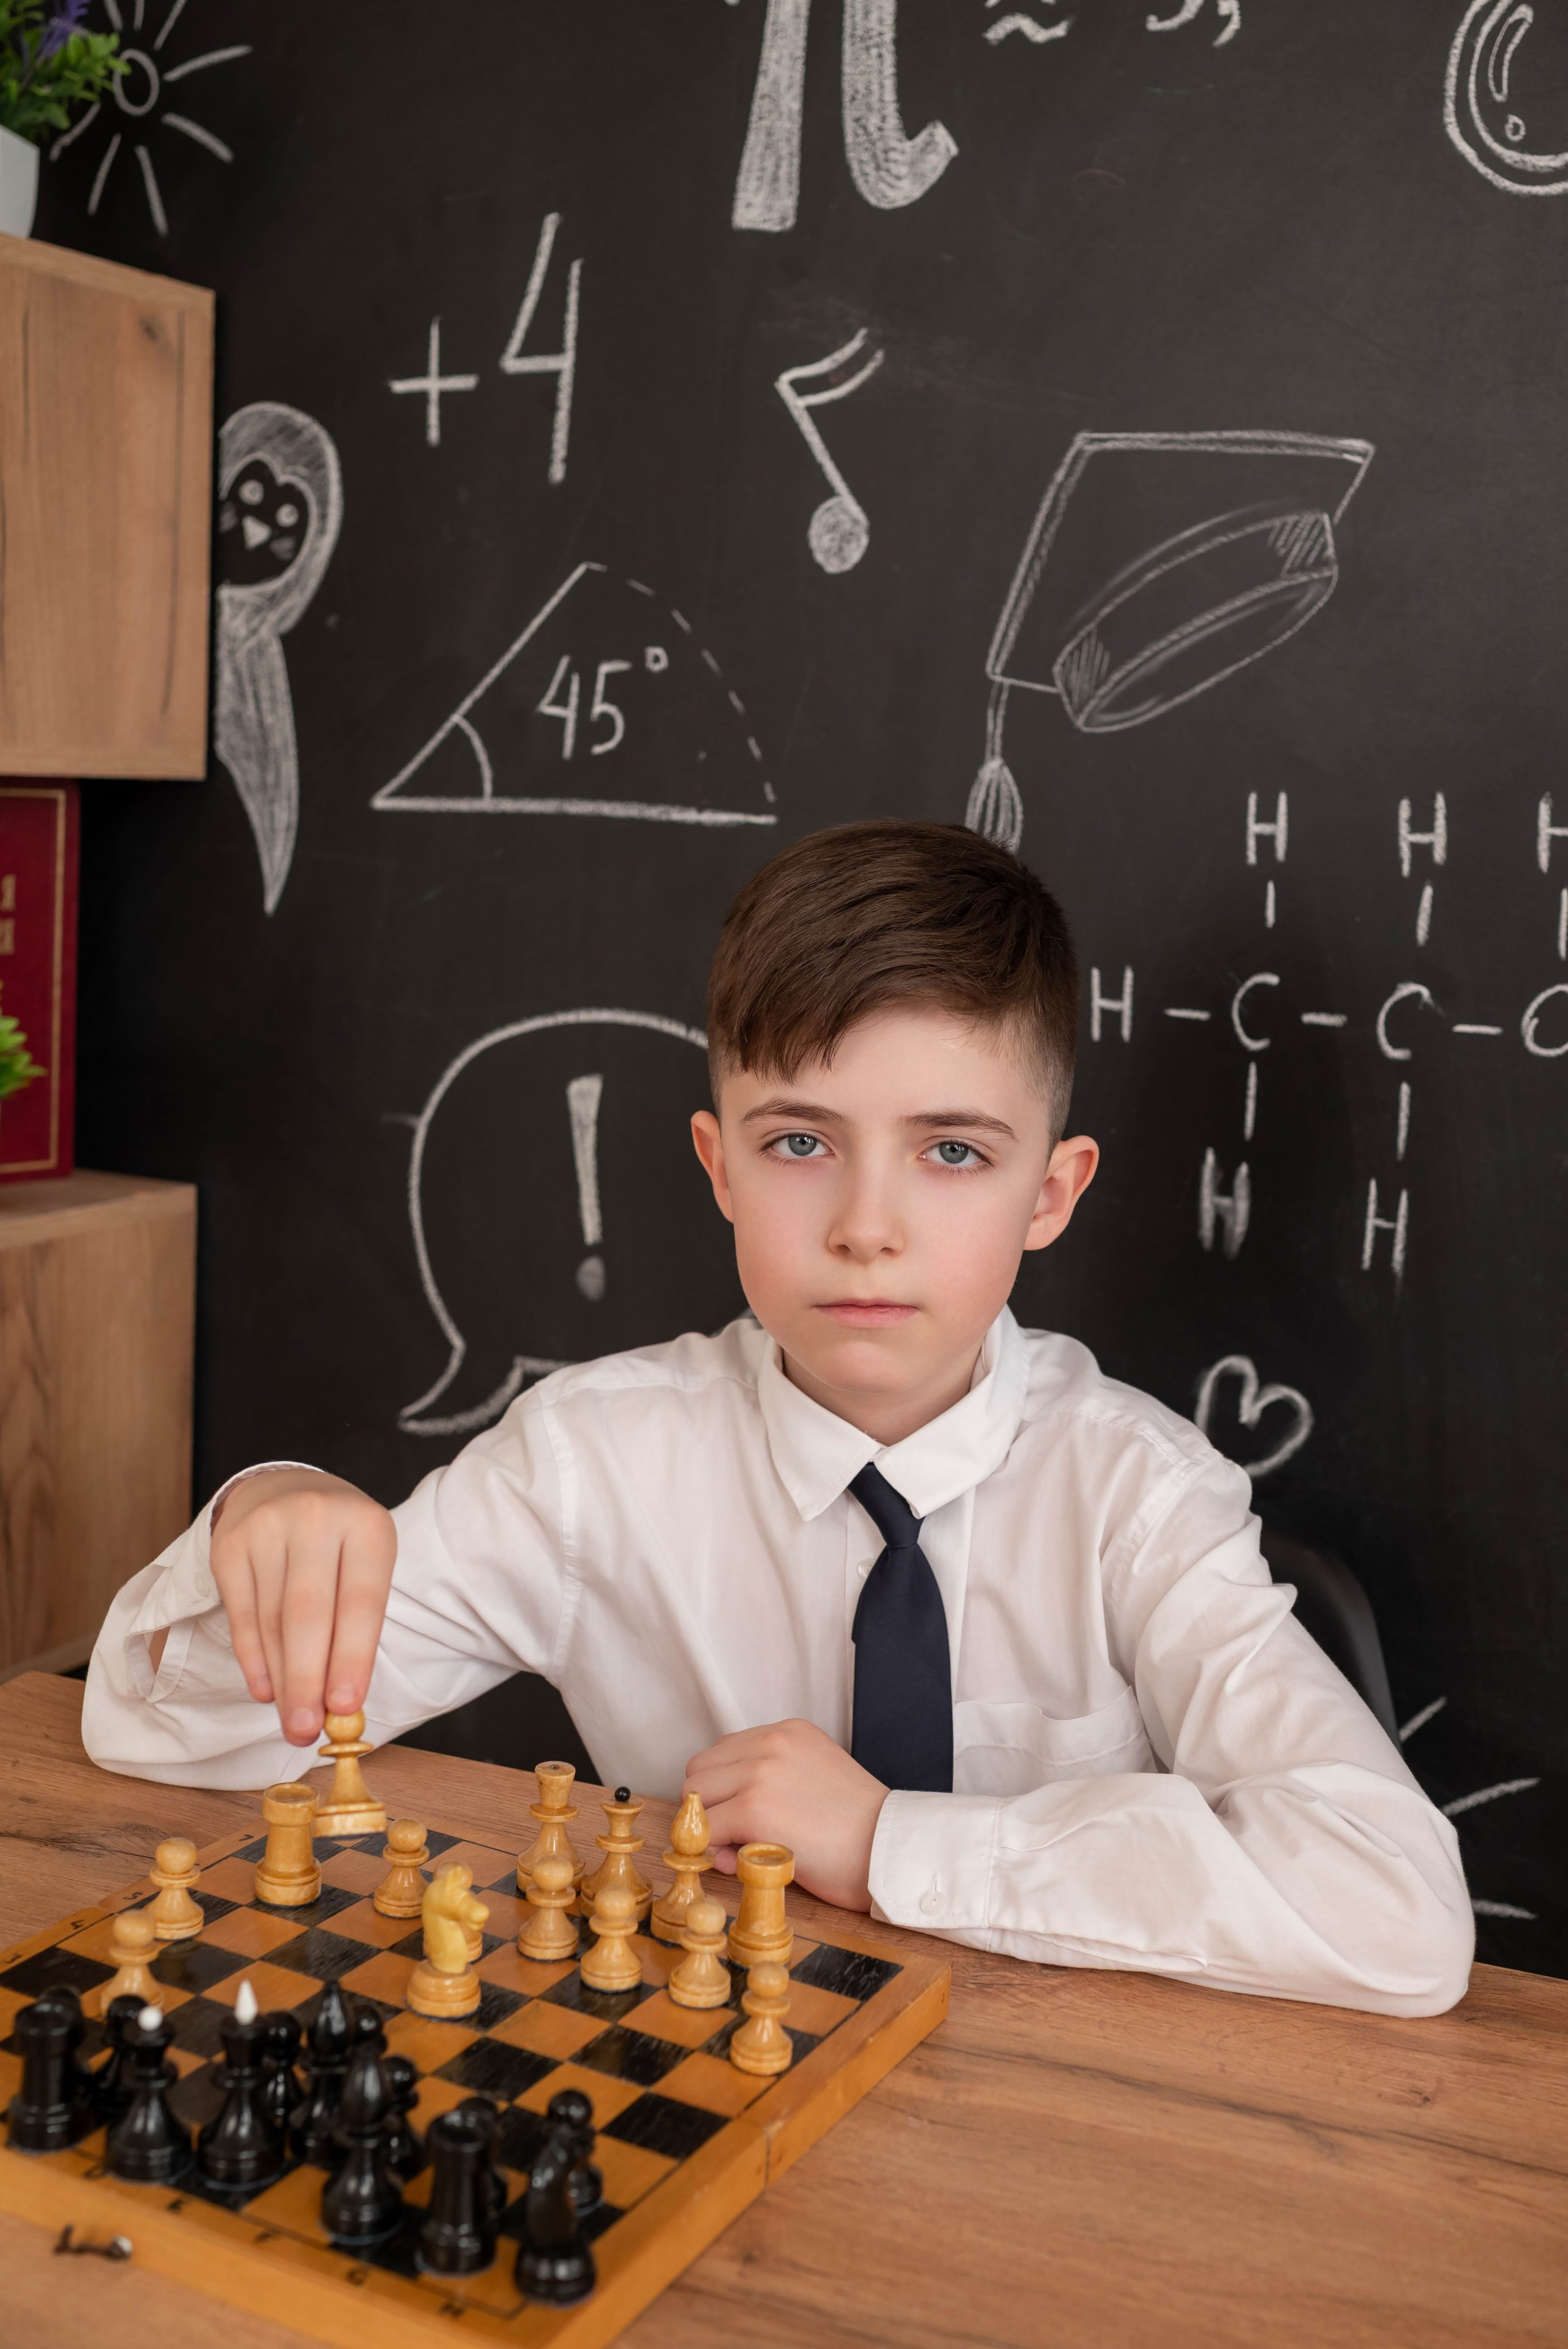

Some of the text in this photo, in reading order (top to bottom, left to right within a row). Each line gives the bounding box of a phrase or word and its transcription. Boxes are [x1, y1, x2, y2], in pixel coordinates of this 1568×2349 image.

[1246, 791, 1288, 865] H
[1398, 792, 1447, 877] H
[1091, 966, 1134, 1042] H
[1232, 973, 1280, 1050] C
[1377, 982, 1433, 1059] C
[1201, 1147, 1250, 1256] H
[1363, 1179, 1408, 1274] H
